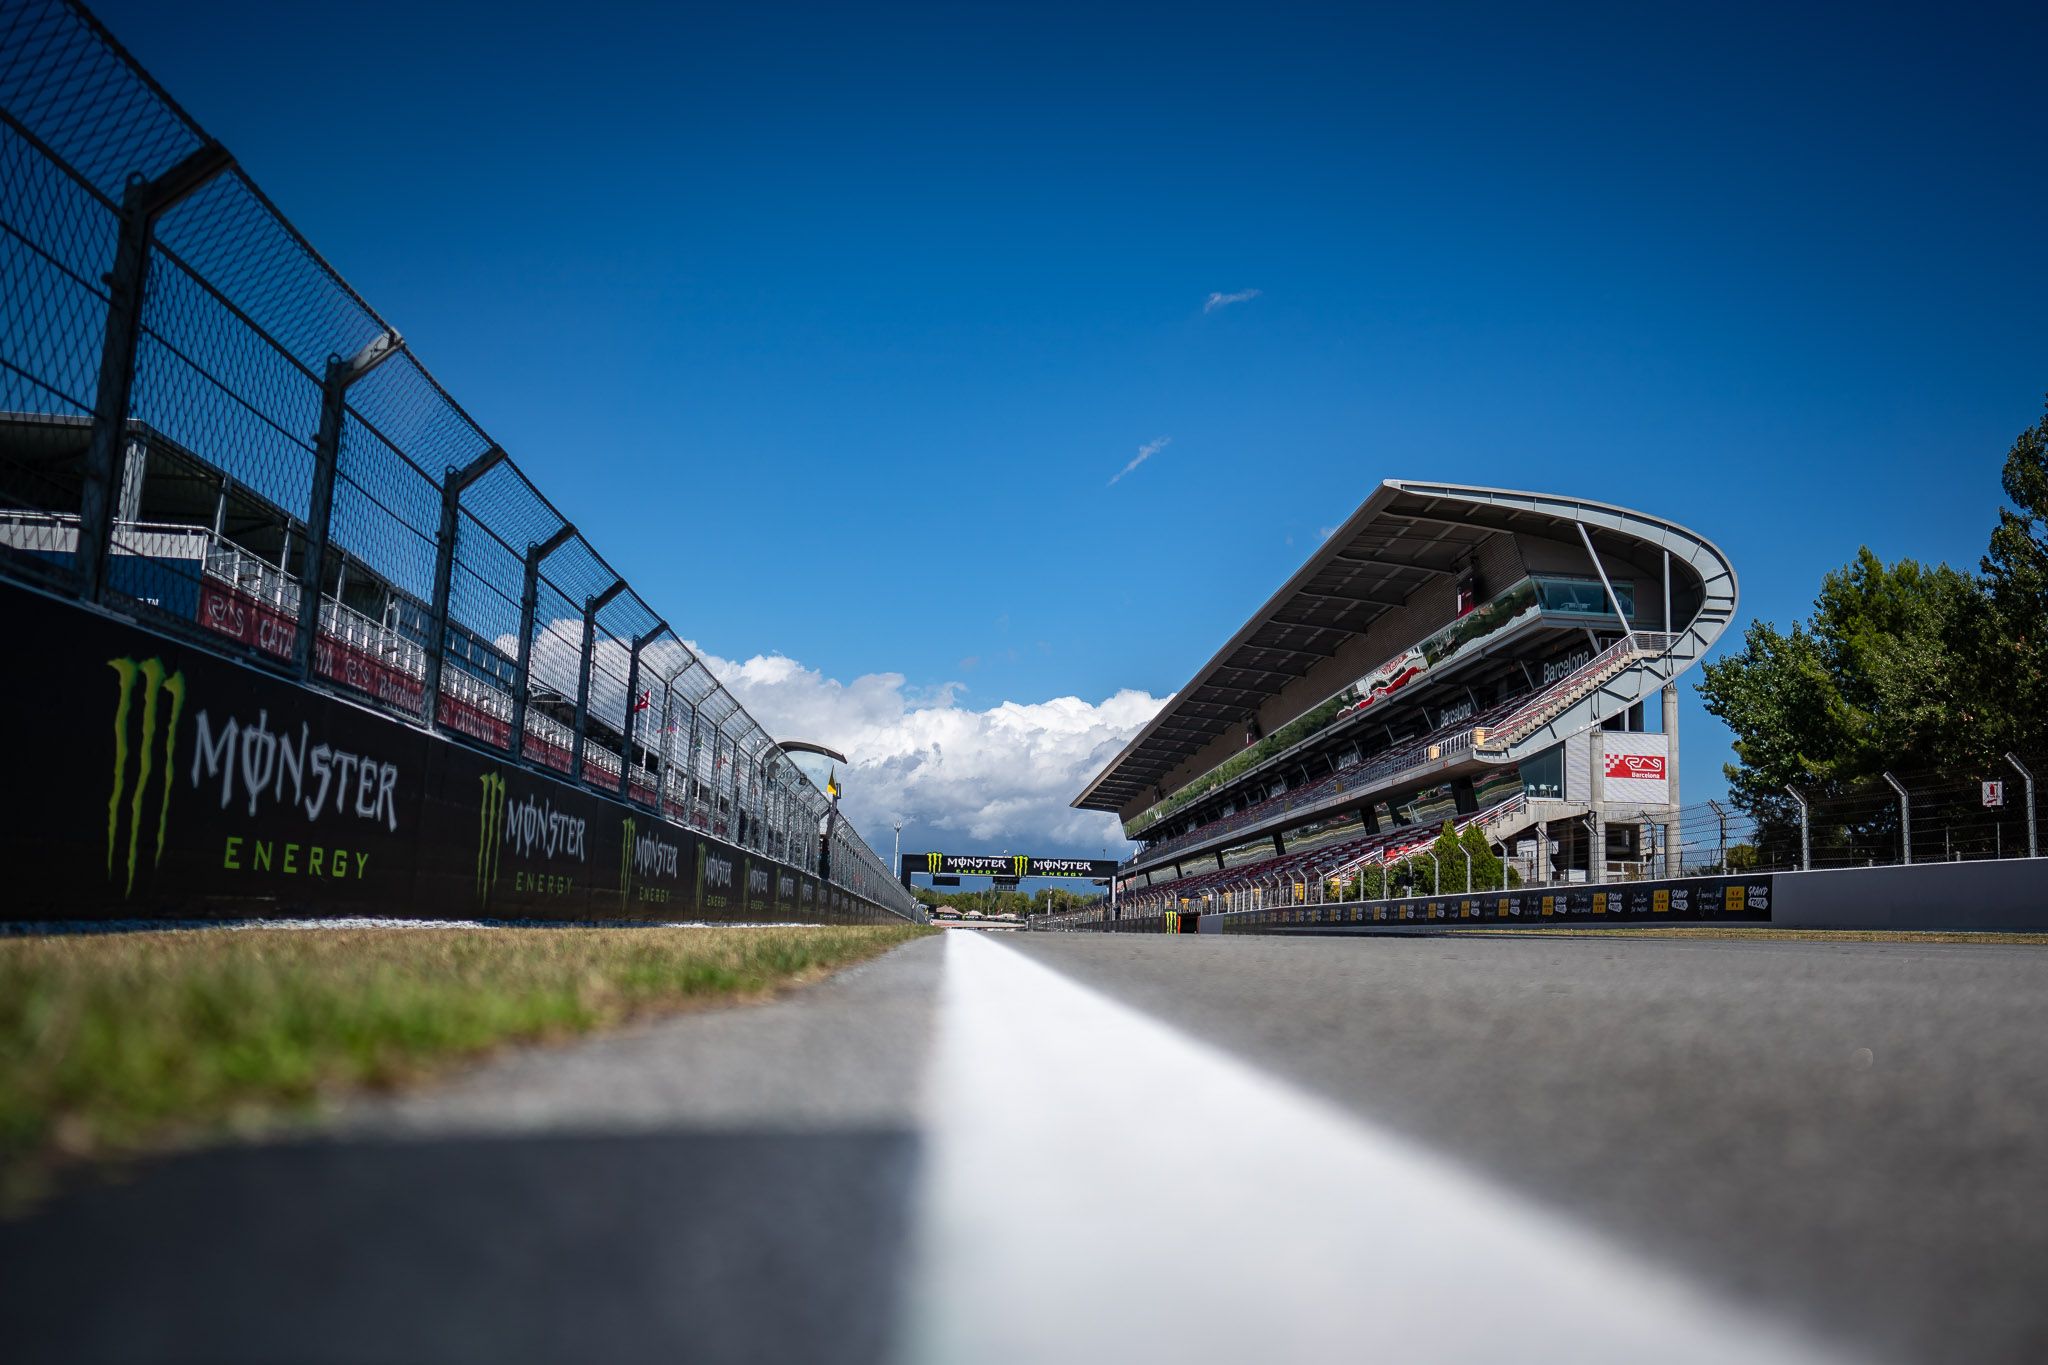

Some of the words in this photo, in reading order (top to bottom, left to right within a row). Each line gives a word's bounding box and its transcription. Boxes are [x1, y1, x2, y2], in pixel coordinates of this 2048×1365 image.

[1543, 650, 1590, 685] Barcelona
[1440, 702, 1472, 728] Barcelona
[191, 709, 398, 833] MONSTER
[1631, 771, 1660, 779] Barcelona
[505, 793, 586, 863] MONSTER
[223, 836, 370, 880] ENERGY
[947, 856, 1007, 869] MONSTER
[1033, 860, 1092, 871] MONSTER
[515, 870, 574, 895] ENERGY
[1748, 886, 1768, 897] GRAND
[639, 885, 671, 903] ENERGY
[1750, 898, 1766, 908] TOUR
